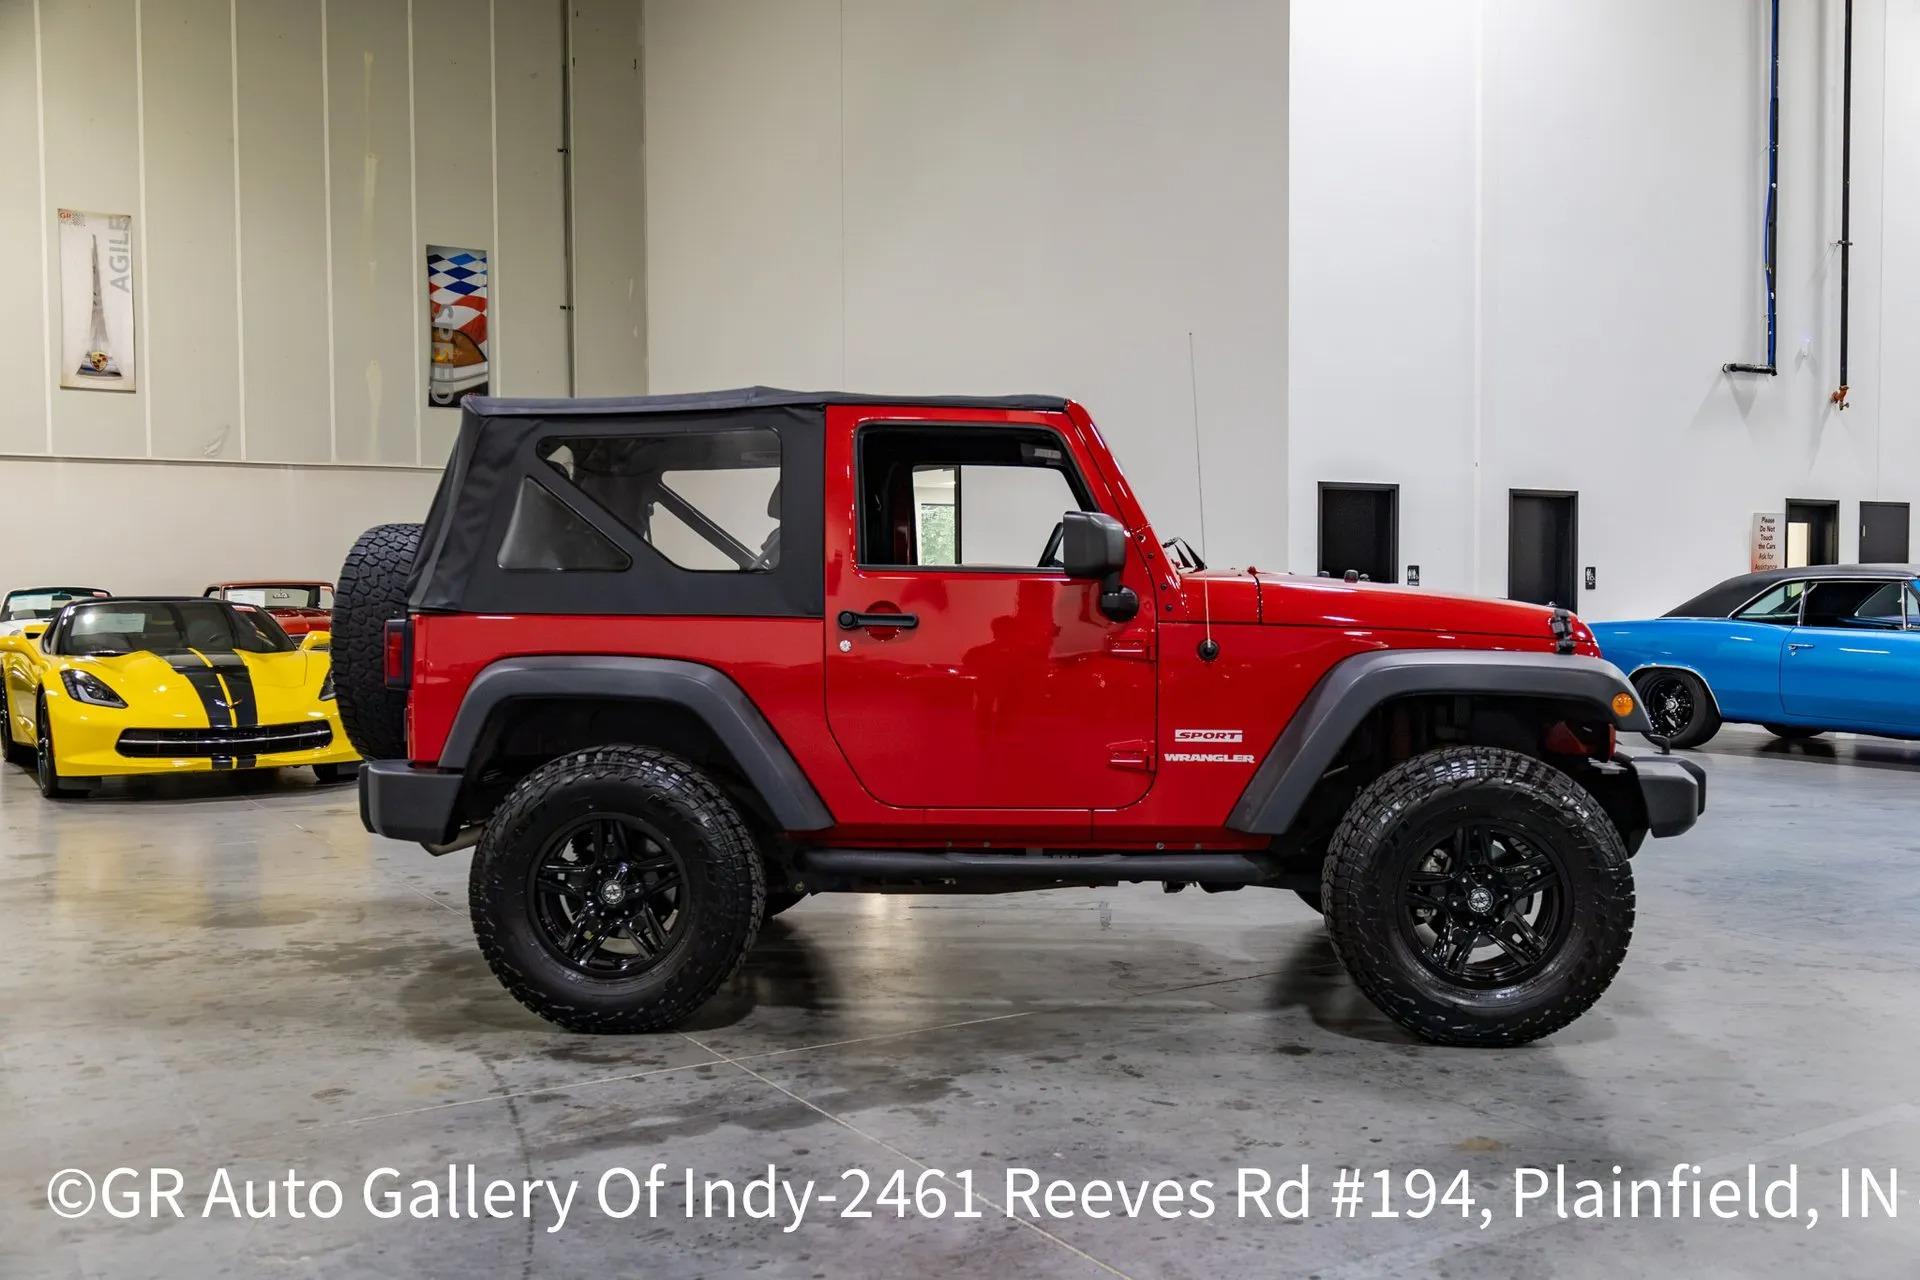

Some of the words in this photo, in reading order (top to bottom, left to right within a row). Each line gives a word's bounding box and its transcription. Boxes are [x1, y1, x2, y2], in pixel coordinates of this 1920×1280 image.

[108, 216, 130, 293] AGILE
[1761, 516, 1775, 524] Please
[1760, 533, 1774, 541] Touch
[1766, 542, 1776, 550] Cars
[1179, 731, 1243, 740] SPORT
[1164, 753, 1255, 763] WRANGLER
